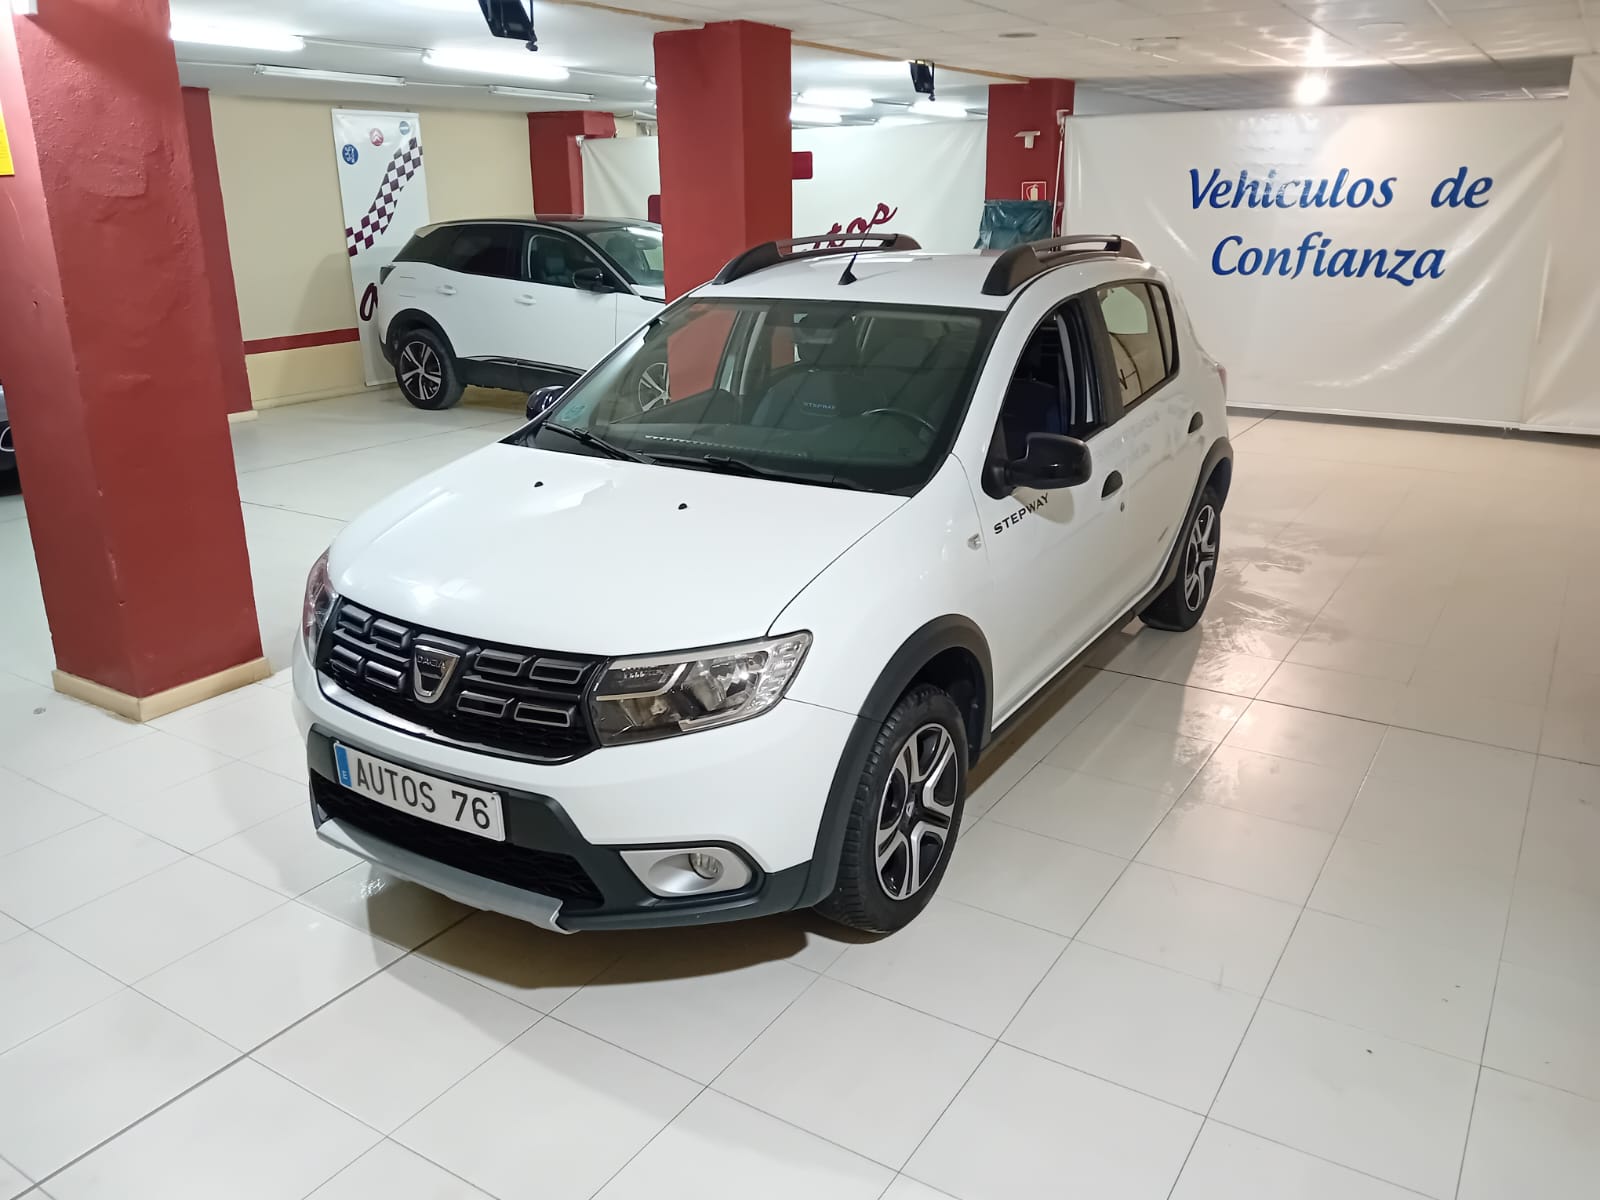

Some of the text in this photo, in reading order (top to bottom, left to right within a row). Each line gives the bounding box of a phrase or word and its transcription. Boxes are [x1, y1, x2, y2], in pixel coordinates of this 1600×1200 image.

[1430, 166, 1494, 209] de
[1211, 231, 1447, 287] Confianza
[993, 491, 1048, 535] STEPWAY
[342, 770, 349, 780] E
[356, 758, 490, 830] AUTOS 76
